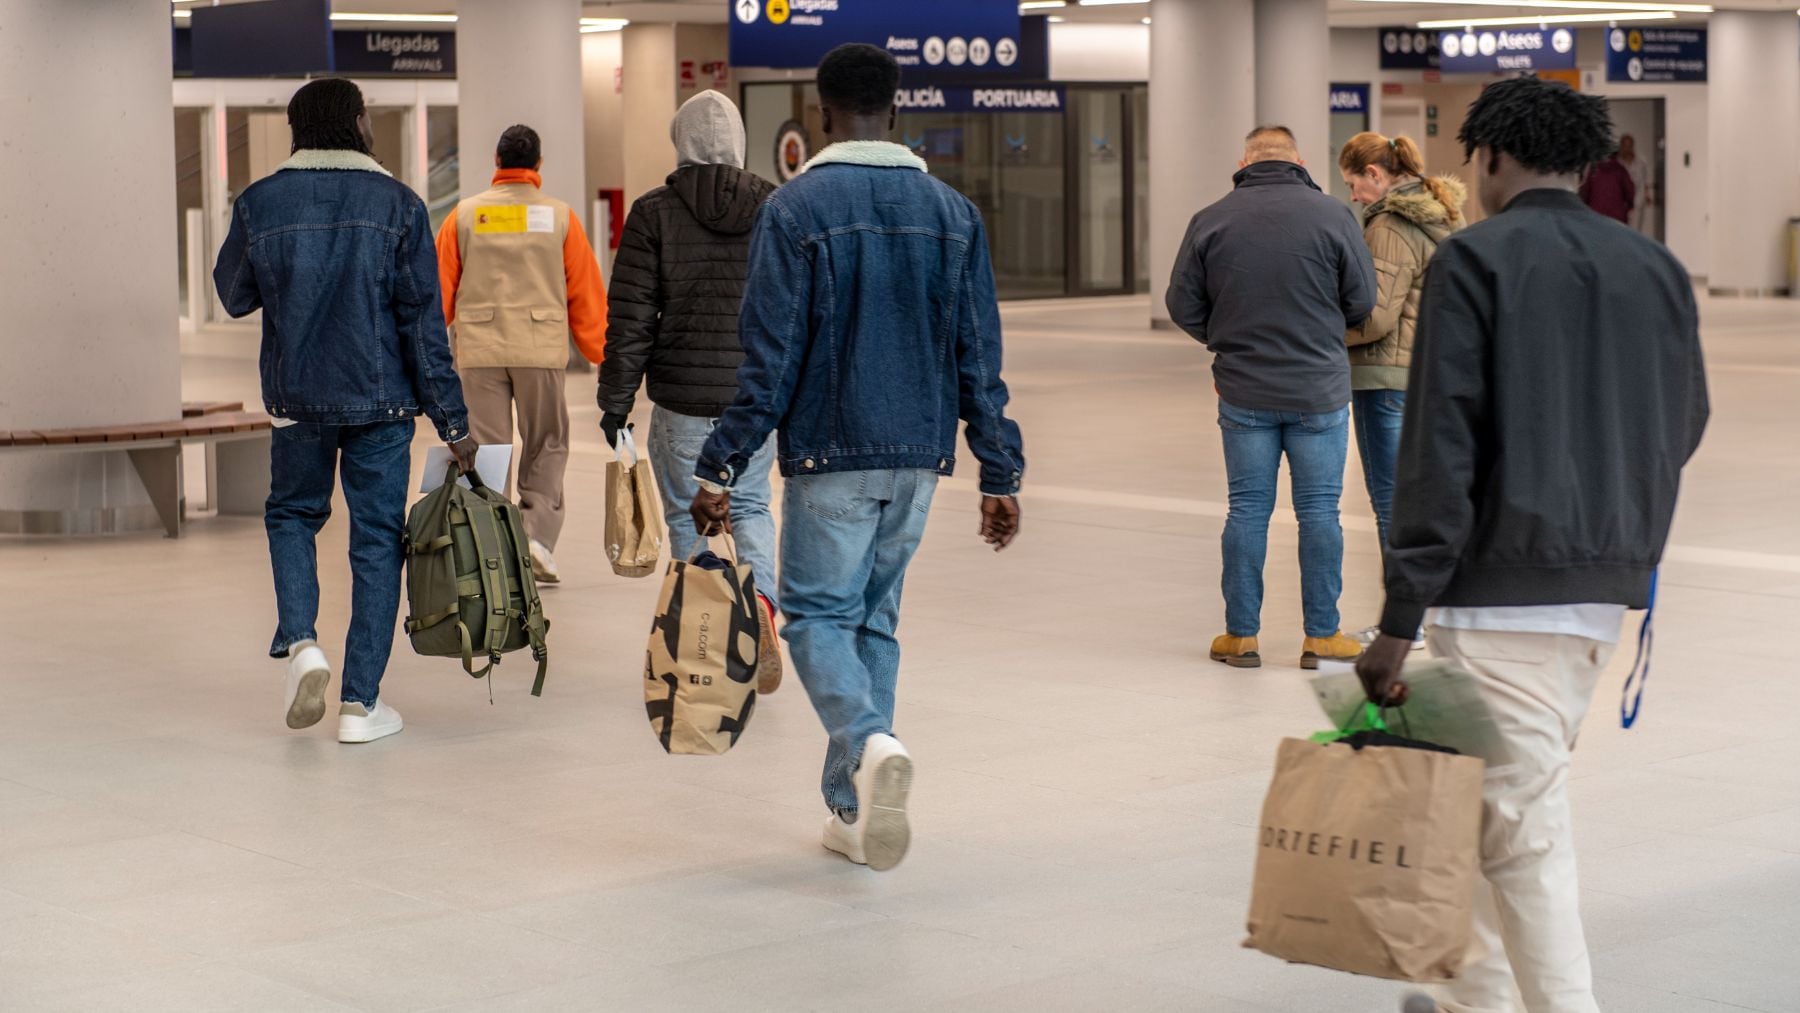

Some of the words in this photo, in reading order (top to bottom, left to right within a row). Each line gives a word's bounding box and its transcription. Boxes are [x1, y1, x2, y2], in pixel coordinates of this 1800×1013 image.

[366, 32, 440, 56] Llegadas
[886, 36, 919, 50] Aseos
[1498, 30, 1543, 50] Aseos
[392, 58, 442, 72] ARRIVALS
[1496, 55, 1532, 69] TOILETS
[894, 86, 946, 107] OLICÍA
[973, 89, 1060, 108] PORTUARIA
[1329, 91, 1362, 109] ARIA
[698, 612, 710, 660] c-a.com
[1257, 825, 1412, 869] ORTEFIEL
